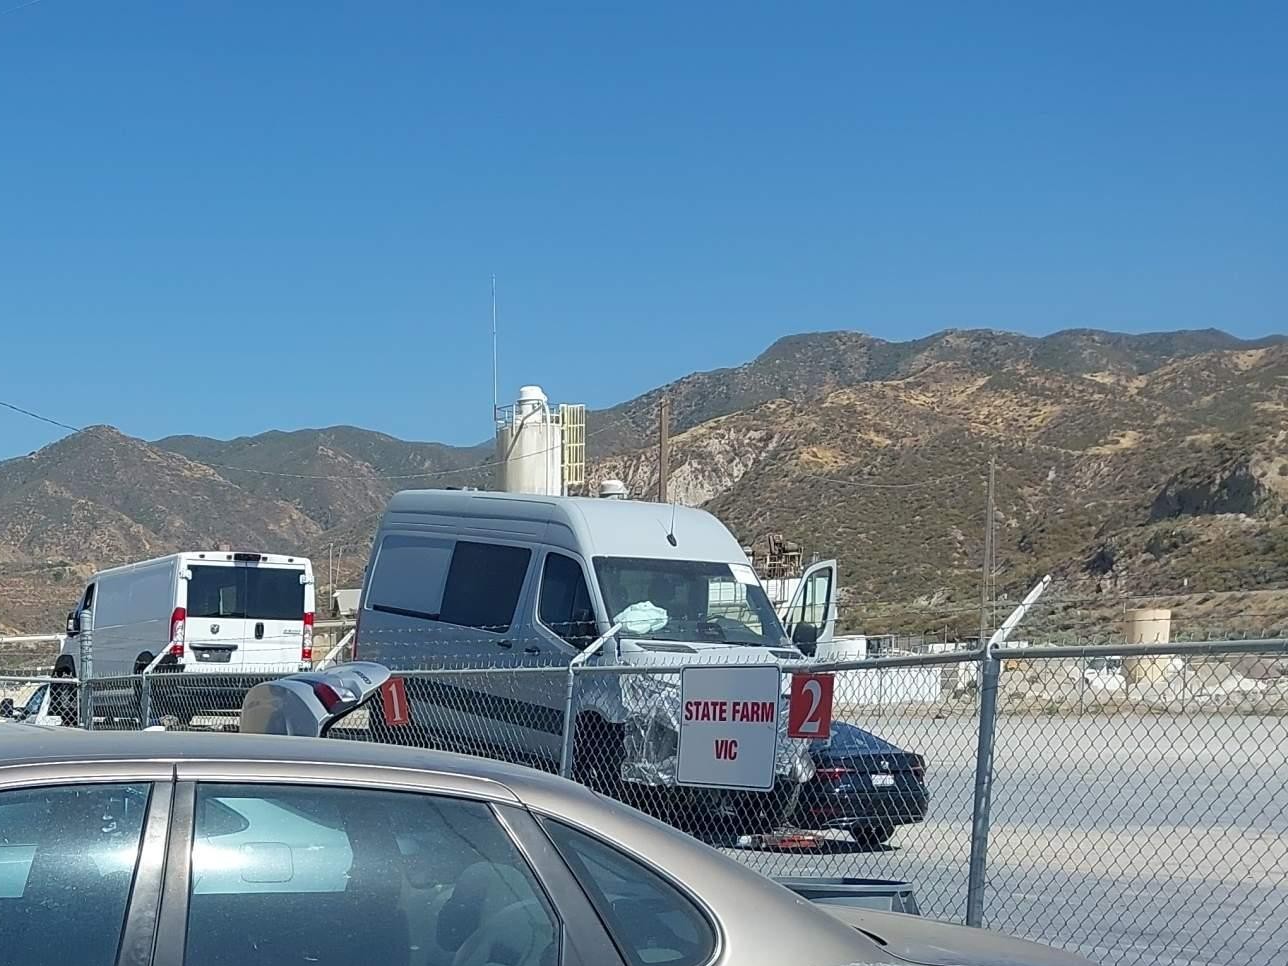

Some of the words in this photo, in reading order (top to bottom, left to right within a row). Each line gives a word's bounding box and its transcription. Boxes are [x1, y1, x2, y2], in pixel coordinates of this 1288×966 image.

[388, 682, 401, 721] 1
[684, 701, 727, 722] STATE
[732, 701, 775, 723] FARM
[798, 679, 823, 733] 2
[714, 739, 738, 760] VIC
